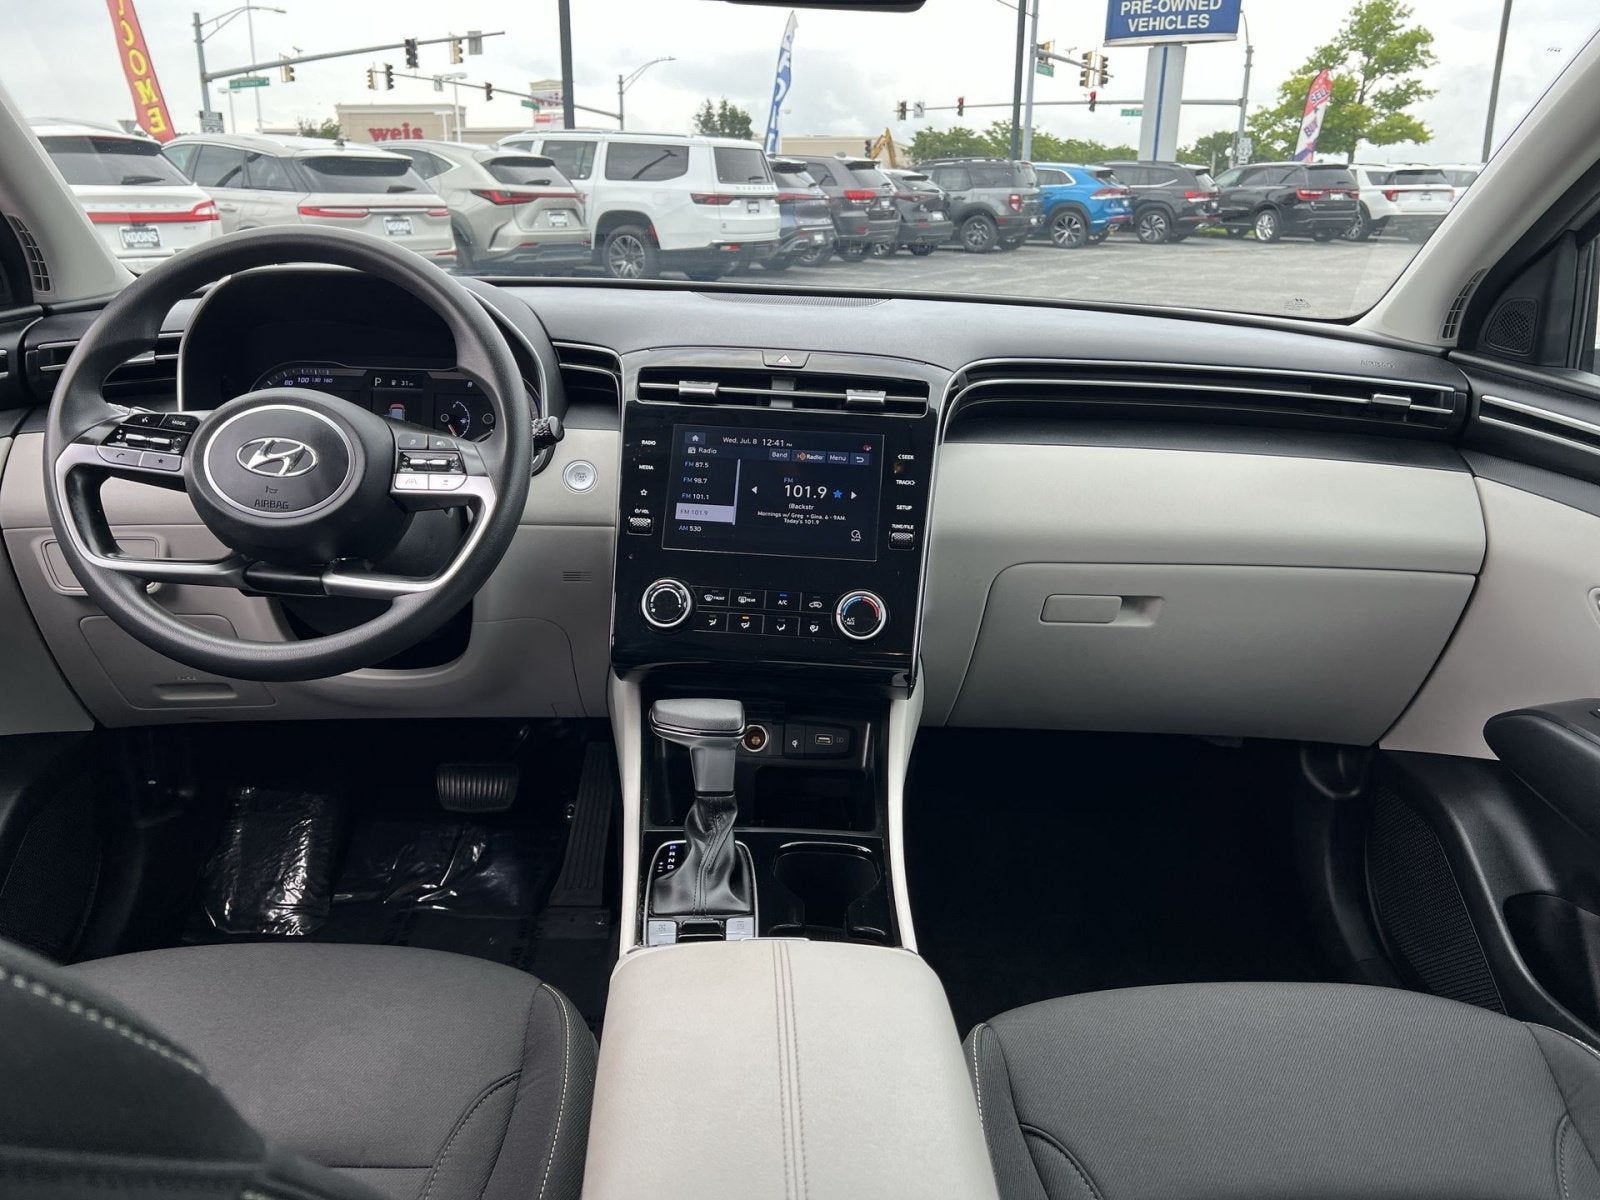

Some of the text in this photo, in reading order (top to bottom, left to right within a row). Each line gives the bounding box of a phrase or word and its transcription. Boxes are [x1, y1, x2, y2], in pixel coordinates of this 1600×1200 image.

[1121, 0, 1221, 15] PRE-OWNED
[1128, 14, 1210, 32] VEHICLES
[1310, 87, 1329, 104] SELL
[368, 122, 424, 141] weis
[374, 377, 381, 386] P
[762, 439, 784, 447] 12:41
[784, 484, 827, 499] 101.9
[254, 500, 289, 509] AIRBAG
